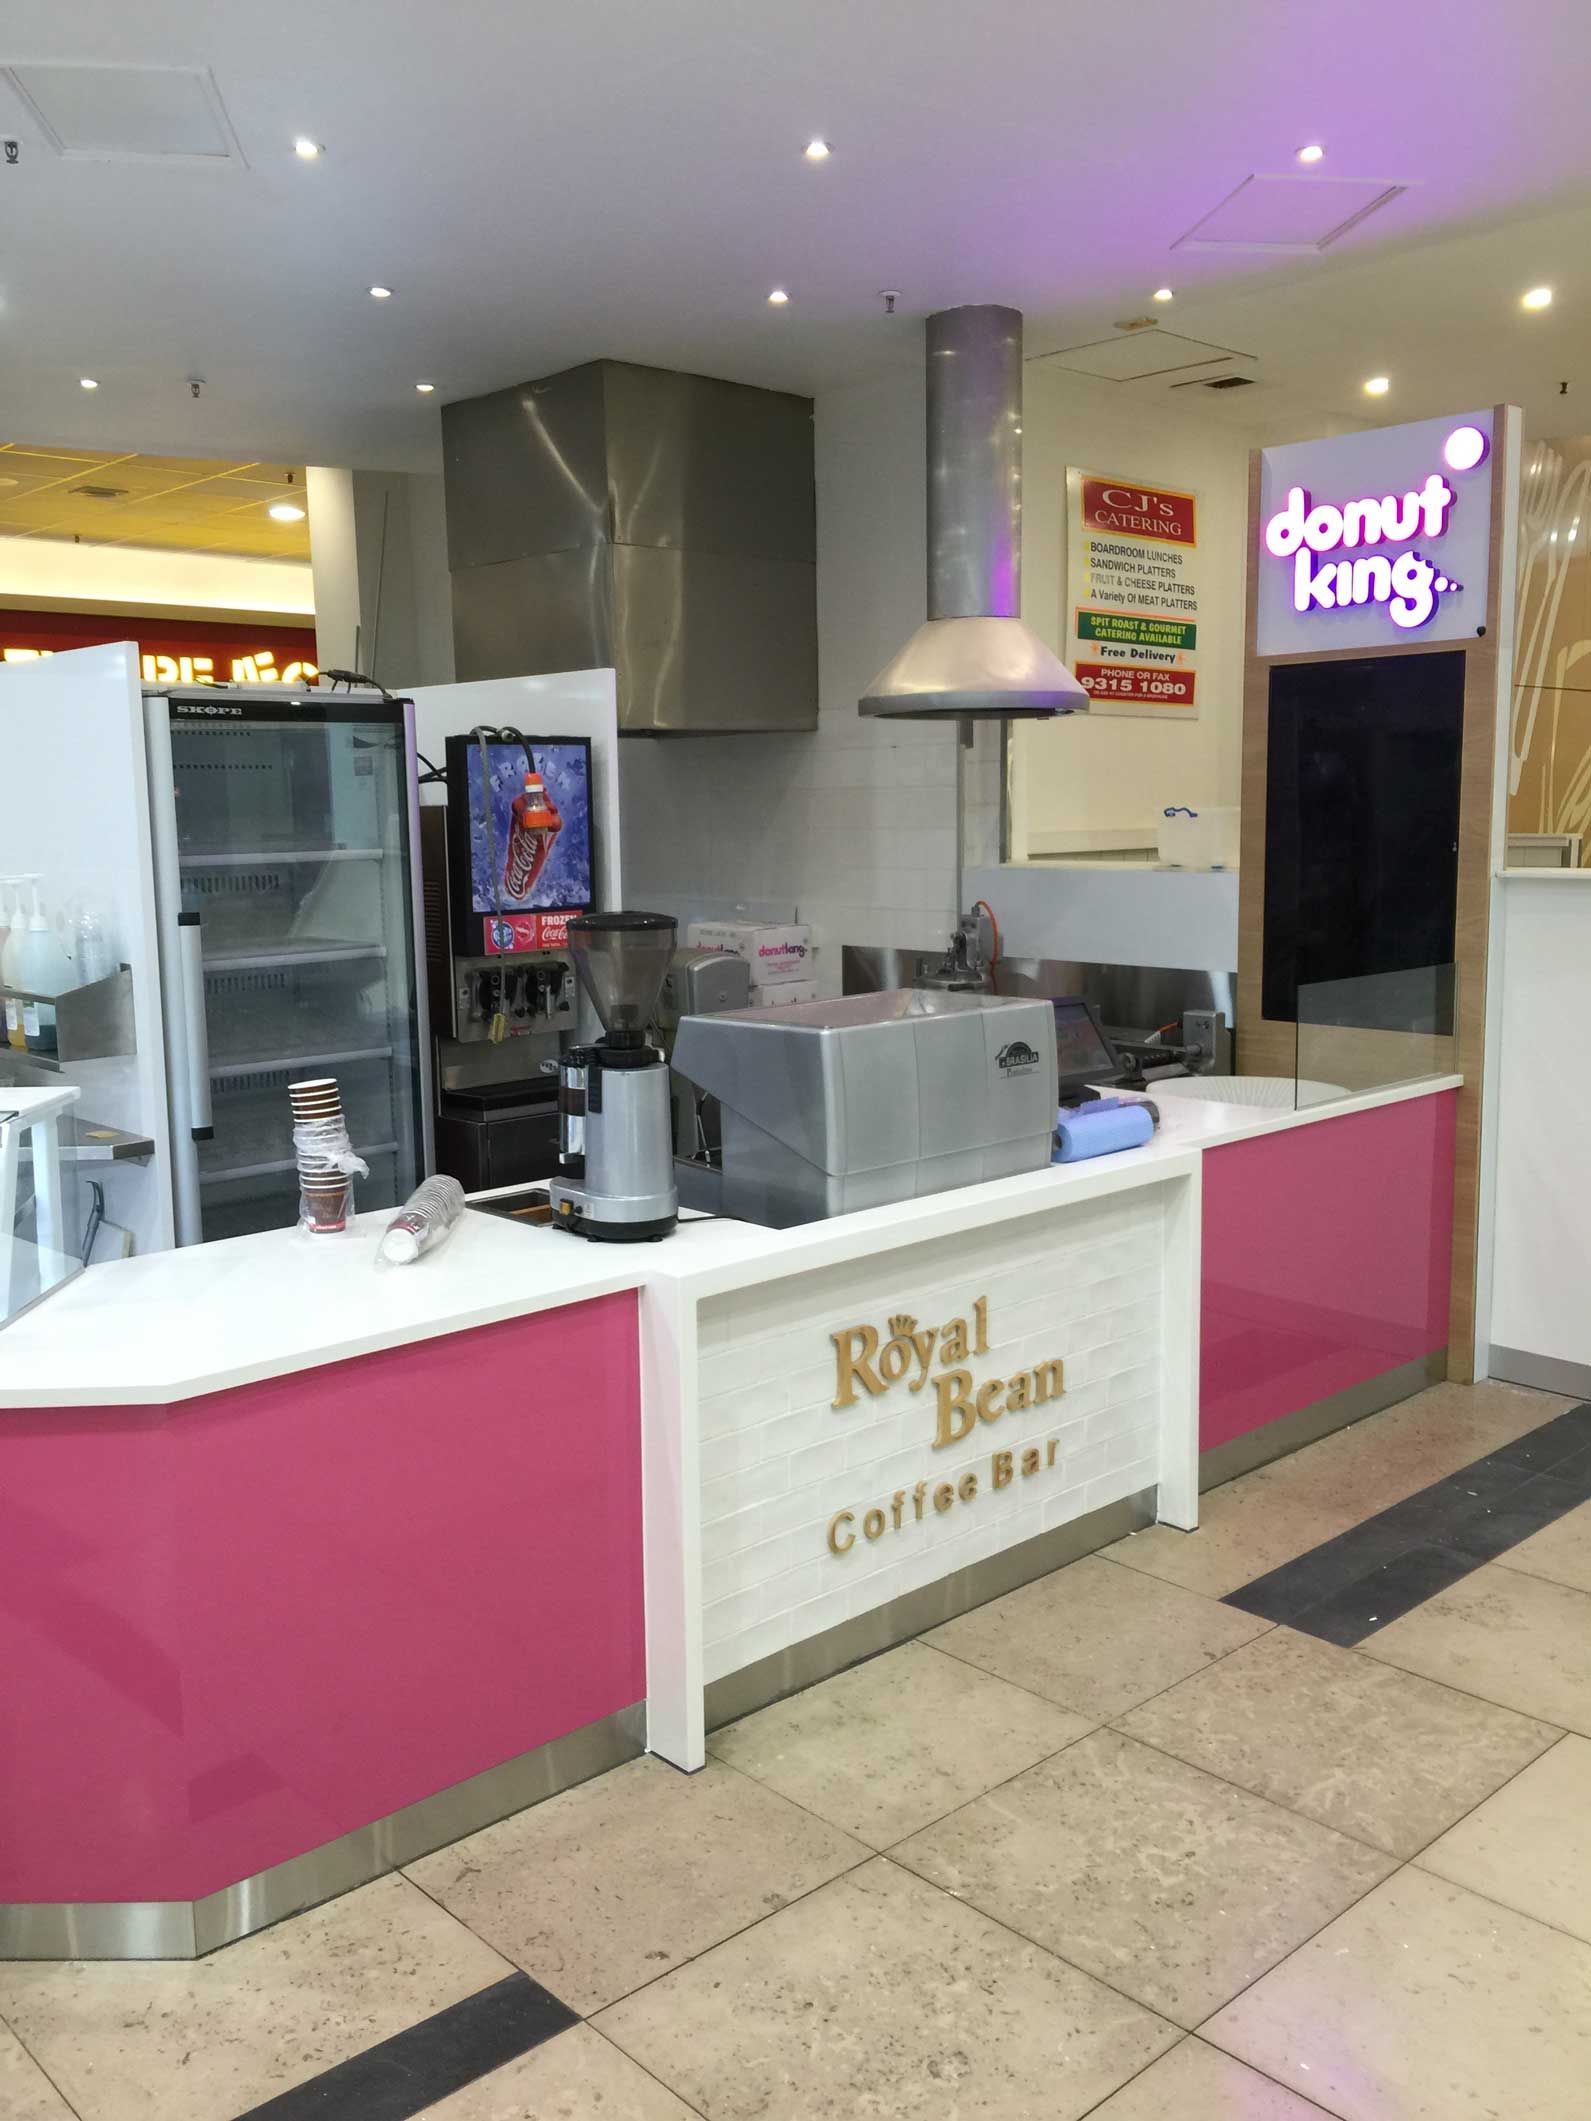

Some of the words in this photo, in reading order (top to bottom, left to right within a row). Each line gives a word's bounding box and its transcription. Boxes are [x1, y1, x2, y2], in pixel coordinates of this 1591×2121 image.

[1102, 489, 1174, 516] CJ's
[1094, 510, 1182, 536] CATERING
[1265, 473, 1457, 557] donut
[1090, 541, 1145, 559] BOARDROOM
[1146, 550, 1183, 565] LUNCHES
[1090, 557, 1136, 574] SANDWICH
[1137, 564, 1176, 579] PLATTERS
[1090, 572, 1115, 585] FRUIT
[1116, 575, 1123, 586] &
[1124, 577, 1157, 590] CHEESE
[1158, 581, 1195, 595] PLATTERS
[1294, 546, 1439, 628] king
[1090, 588, 1097, 599] A
[1098, 589, 1125, 604] Variety
[1138, 594, 1160, 605] MEAT
[1161, 597, 1198, 611] PLATTERS
[1090, 616, 1110, 627] SPIT
[1111, 618, 1139, 630] ROAST
[1140, 622, 1147, 631] &
[1149, 623, 1186, 635] GOURMET
[1095, 628, 1137, 641] CATERING
[1139, 632, 1182, 645] AVAILABLE
[1100, 646, 1126, 657] Free
[1130, 648, 1176, 664] Delivery
[1081, 676, 1133, 692] 9315
[1140, 681, 1186, 695] 1080
[1101, 668, 1135, 679] PHONE
[1136, 671, 1151, 680] OR
[1152, 672, 1170, 681] FAX
[176, 704, 243, 716] SKOPE
[830, 1295, 990, 1409] Royal
[931, 1358, 1066, 1450] Bean
[827, 1471, 979, 1554] Coffee
[991, 1438, 1060, 1490] Bar
